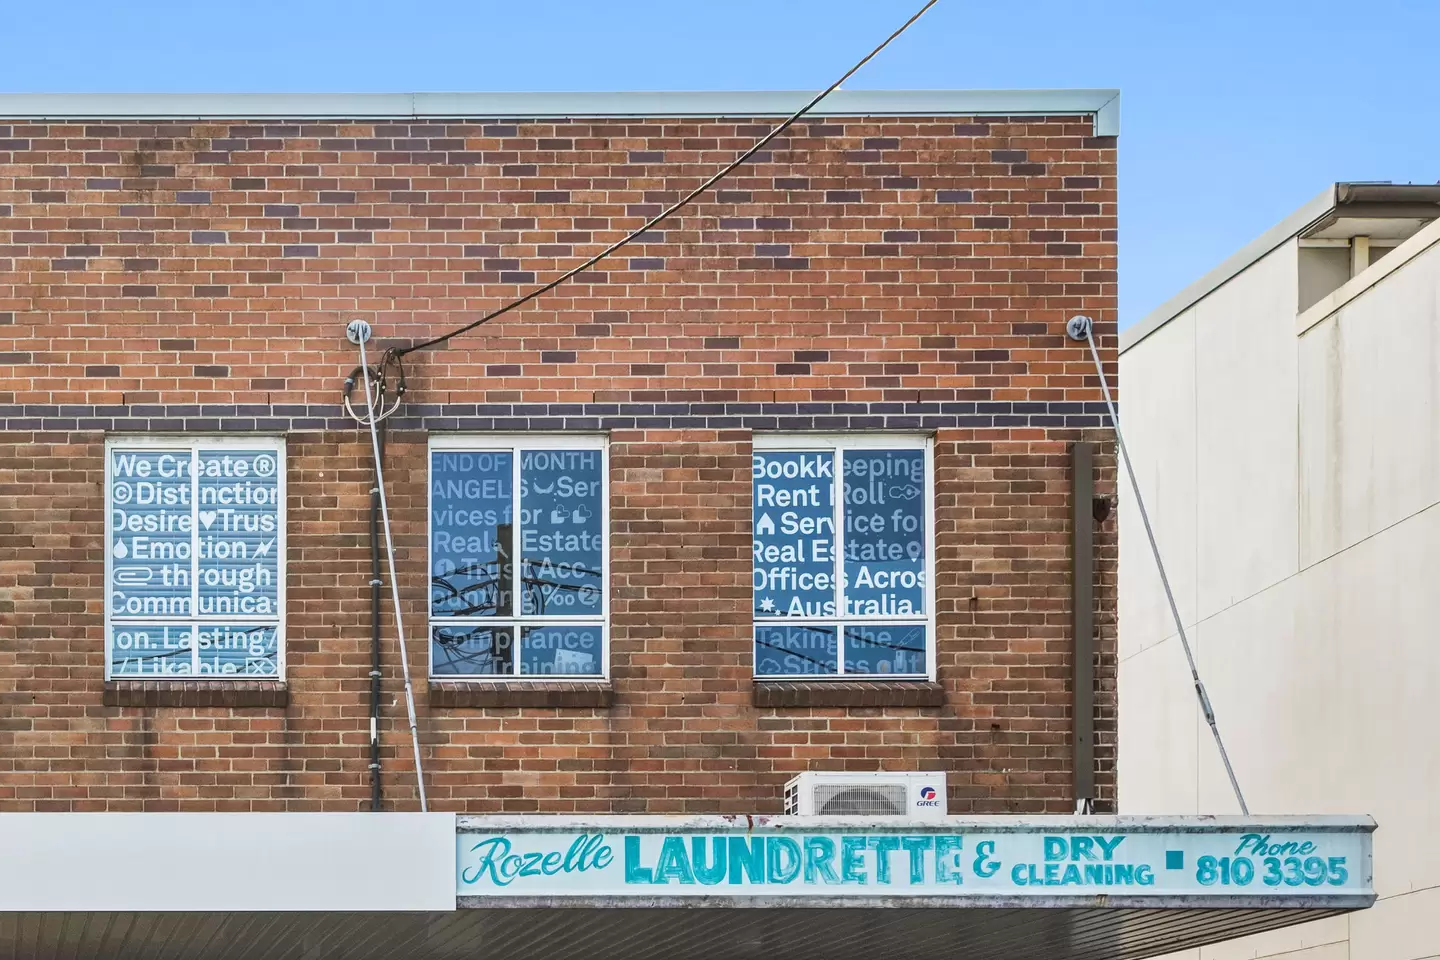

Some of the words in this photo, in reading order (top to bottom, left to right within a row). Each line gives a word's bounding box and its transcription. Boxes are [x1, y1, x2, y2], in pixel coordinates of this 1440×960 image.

[113, 455, 151, 477] We
[158, 454, 248, 477] Create
[432, 453, 472, 472] END
[478, 453, 506, 472] OF
[521, 452, 594, 470] MONTH
[433, 476, 528, 499] ANGELS
[556, 476, 600, 497] Ser
[758, 484, 820, 507] Rent
[829, 482, 885, 506] Roll
[113, 509, 192, 532] Desire
[433, 504, 497, 526] vices
[503, 504, 542, 525] for
[780, 511, 884, 534] Service
[133, 537, 247, 559] Emotion
[434, 530, 489, 553] Real
[523, 529, 601, 552] Estate
[753, 539, 805, 562] Real
[812, 539, 902, 562] Estate
[753, 567, 849, 590] Offices
[164, 626, 264, 656] Lasting
[758, 627, 837, 654] Taking
[850, 627, 891, 648] the
[1044, 836, 1126, 862] DRY
[1234, 833, 1317, 857] Phone
[462, 833, 614, 887] Rozelle
[623, 835, 963, 886] LAUNDRETTE
[974, 840, 1001, 878] &
[1195, 855, 1254, 886] 810
[1262, 855, 1349, 887] 3395
[1010, 863, 1155, 886] CLEANING
